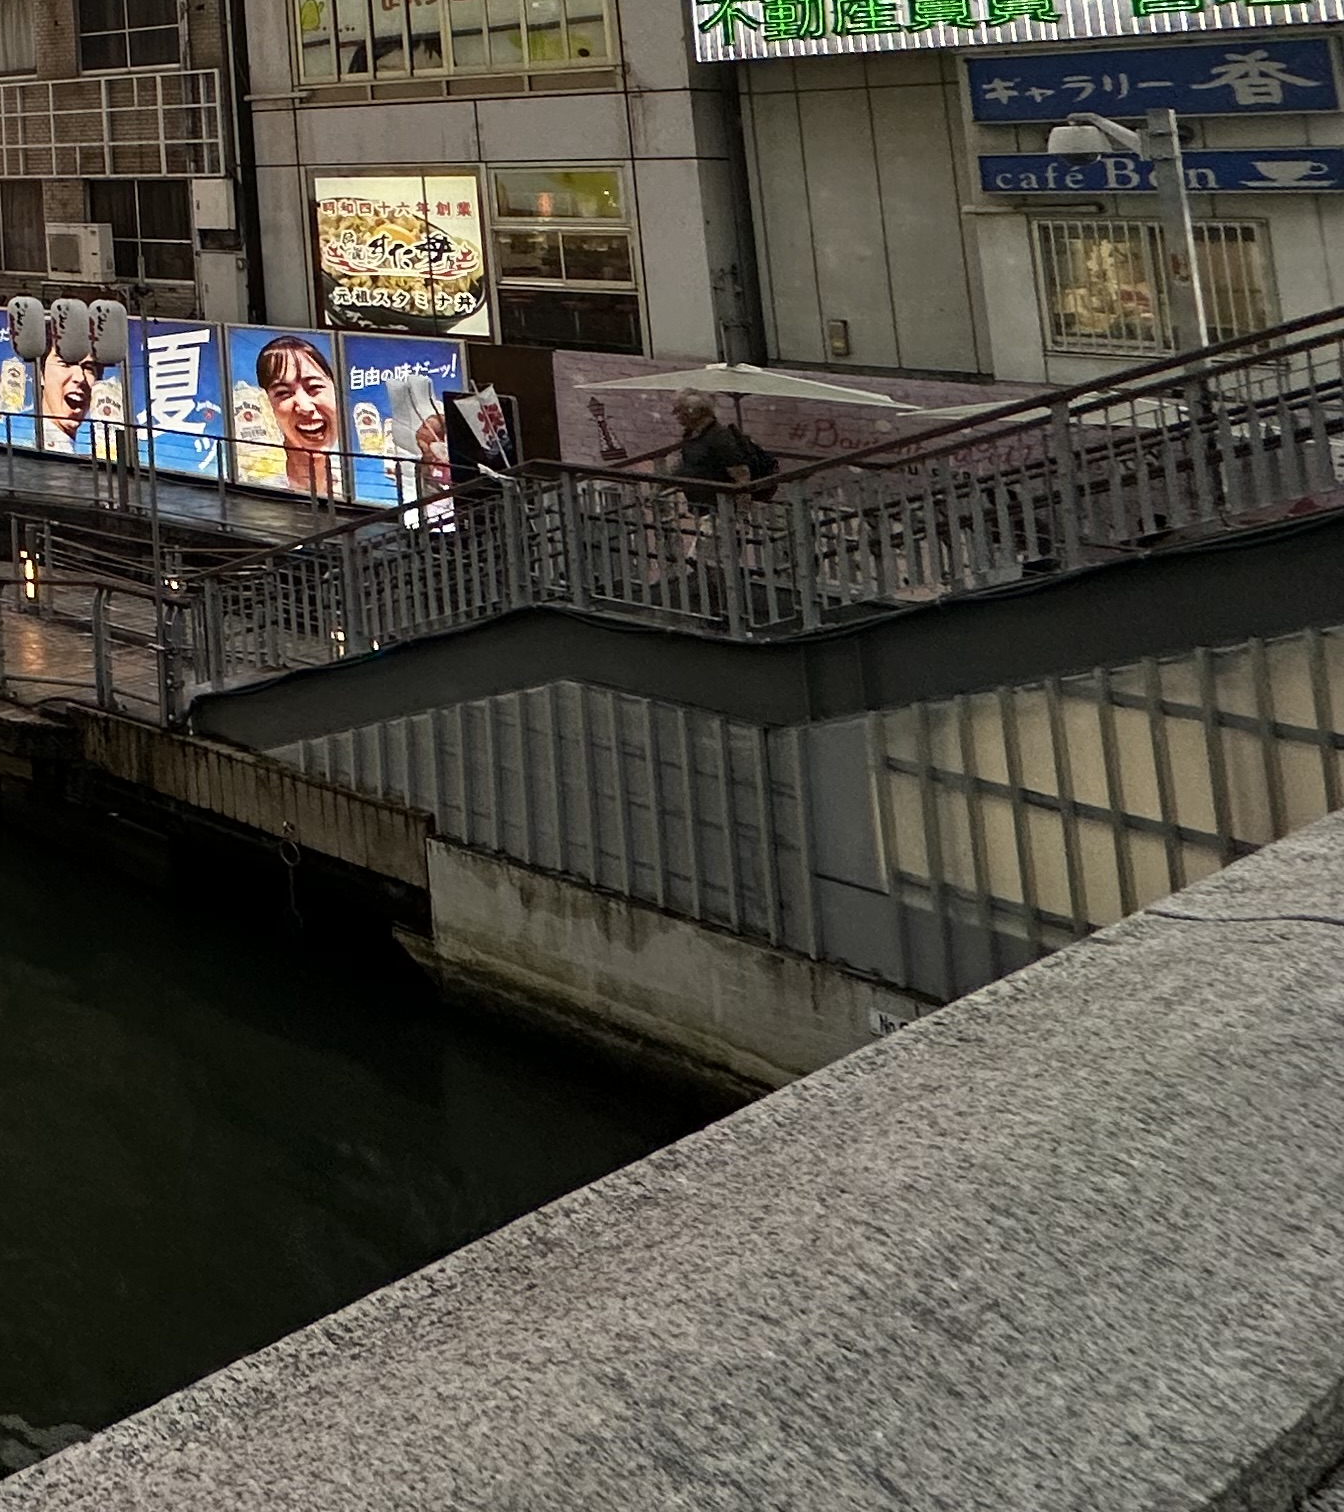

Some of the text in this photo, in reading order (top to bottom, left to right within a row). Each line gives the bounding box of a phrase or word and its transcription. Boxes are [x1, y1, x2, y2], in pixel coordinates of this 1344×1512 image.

[982, 49, 1322, 106] ギャラリー 香
[994, 156, 1223, 192] café Bn
